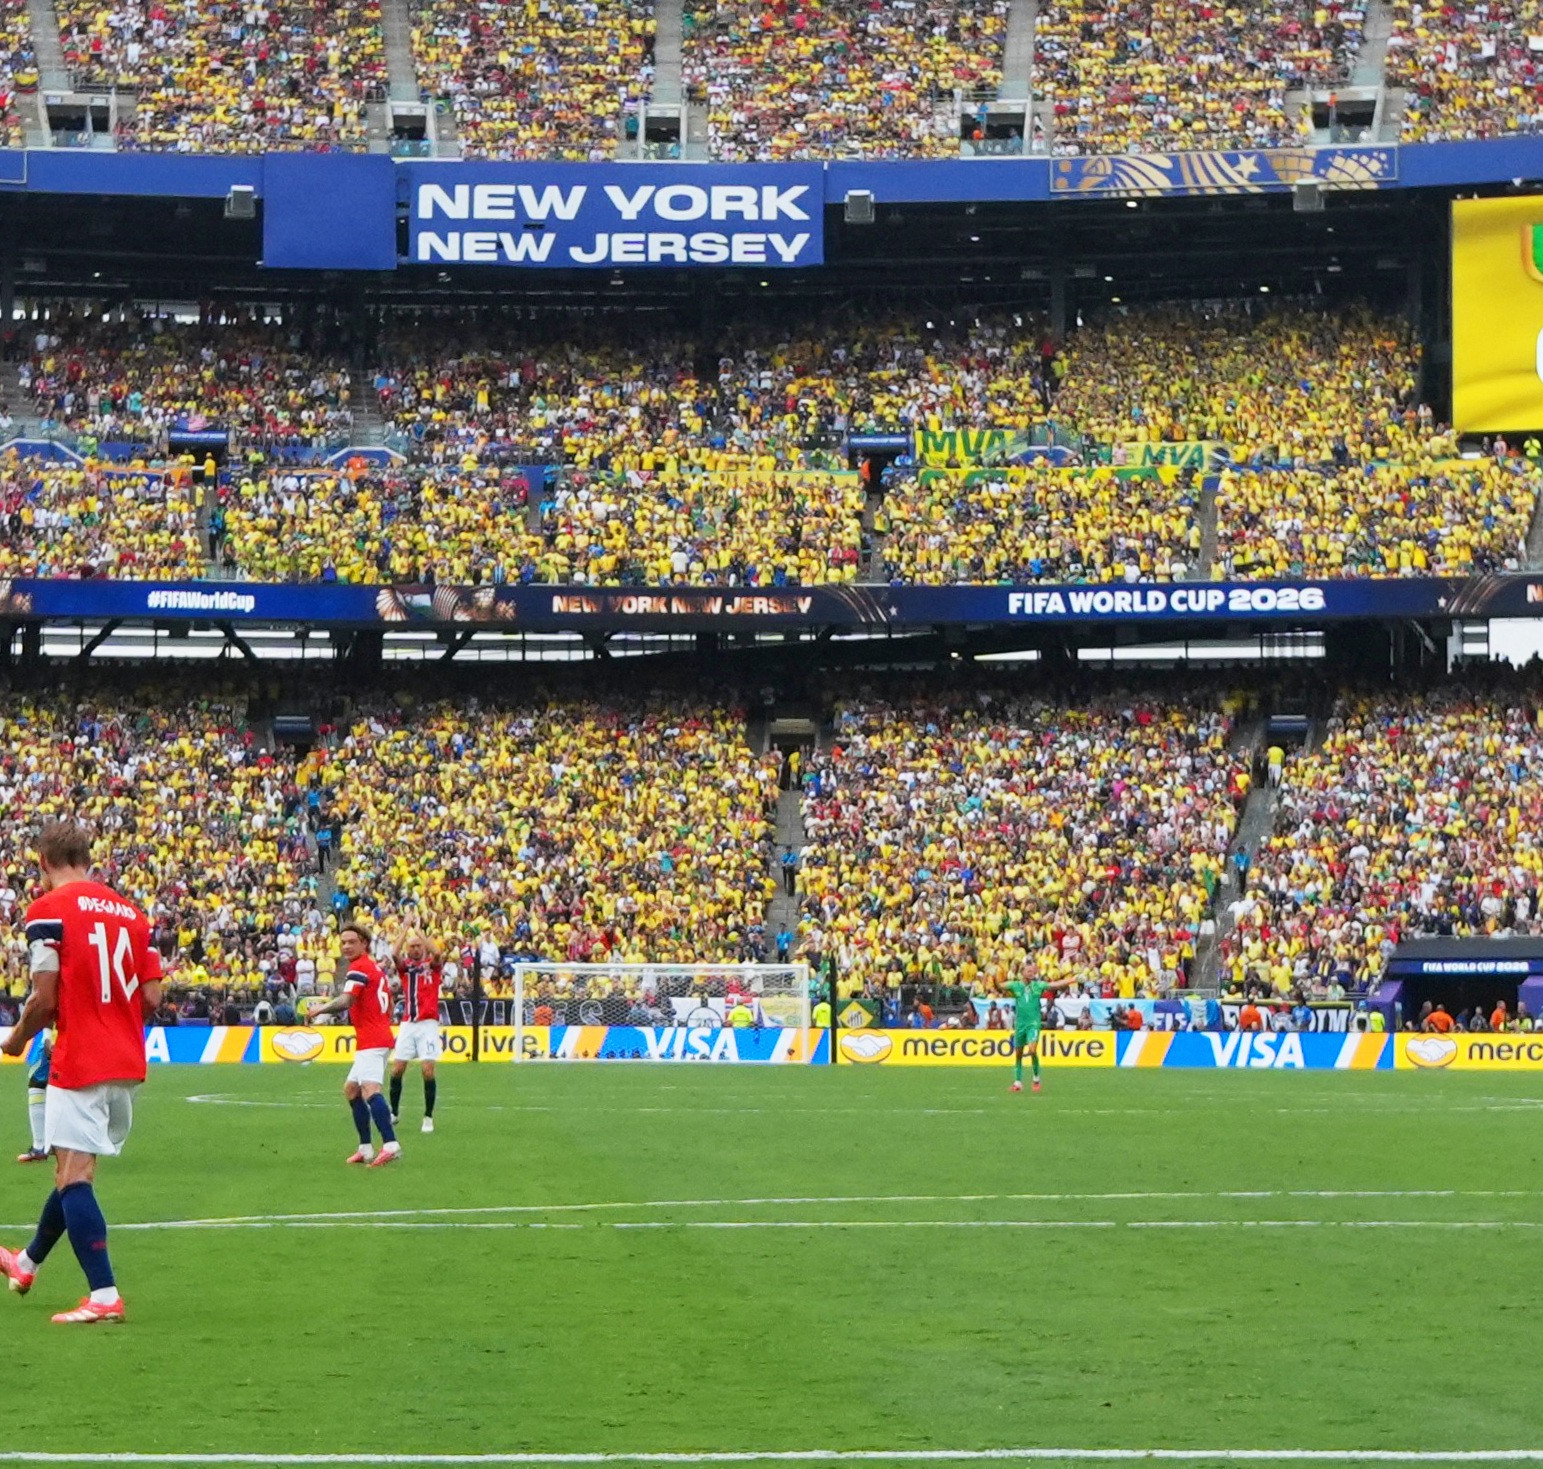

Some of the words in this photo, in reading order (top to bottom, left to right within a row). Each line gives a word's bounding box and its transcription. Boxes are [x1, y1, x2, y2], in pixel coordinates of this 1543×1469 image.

[417, 183, 588, 220] NEW
[603, 184, 811, 221] YORK
[417, 231, 557, 262] NEW
[568, 231, 811, 263] JERSEY
[147, 589, 255, 613] #FIFAWorldCup
[1008, 591, 1067, 614] FIFA
[1068, 589, 1167, 613] WORLD
[1170, 589, 1225, 612] CUP
[1228, 587, 1325, 611] 2026
[635, 1026, 740, 1062] VISA
[1041, 1033, 1105, 1058] livre
[1201, 1031, 1305, 1068] VISA
